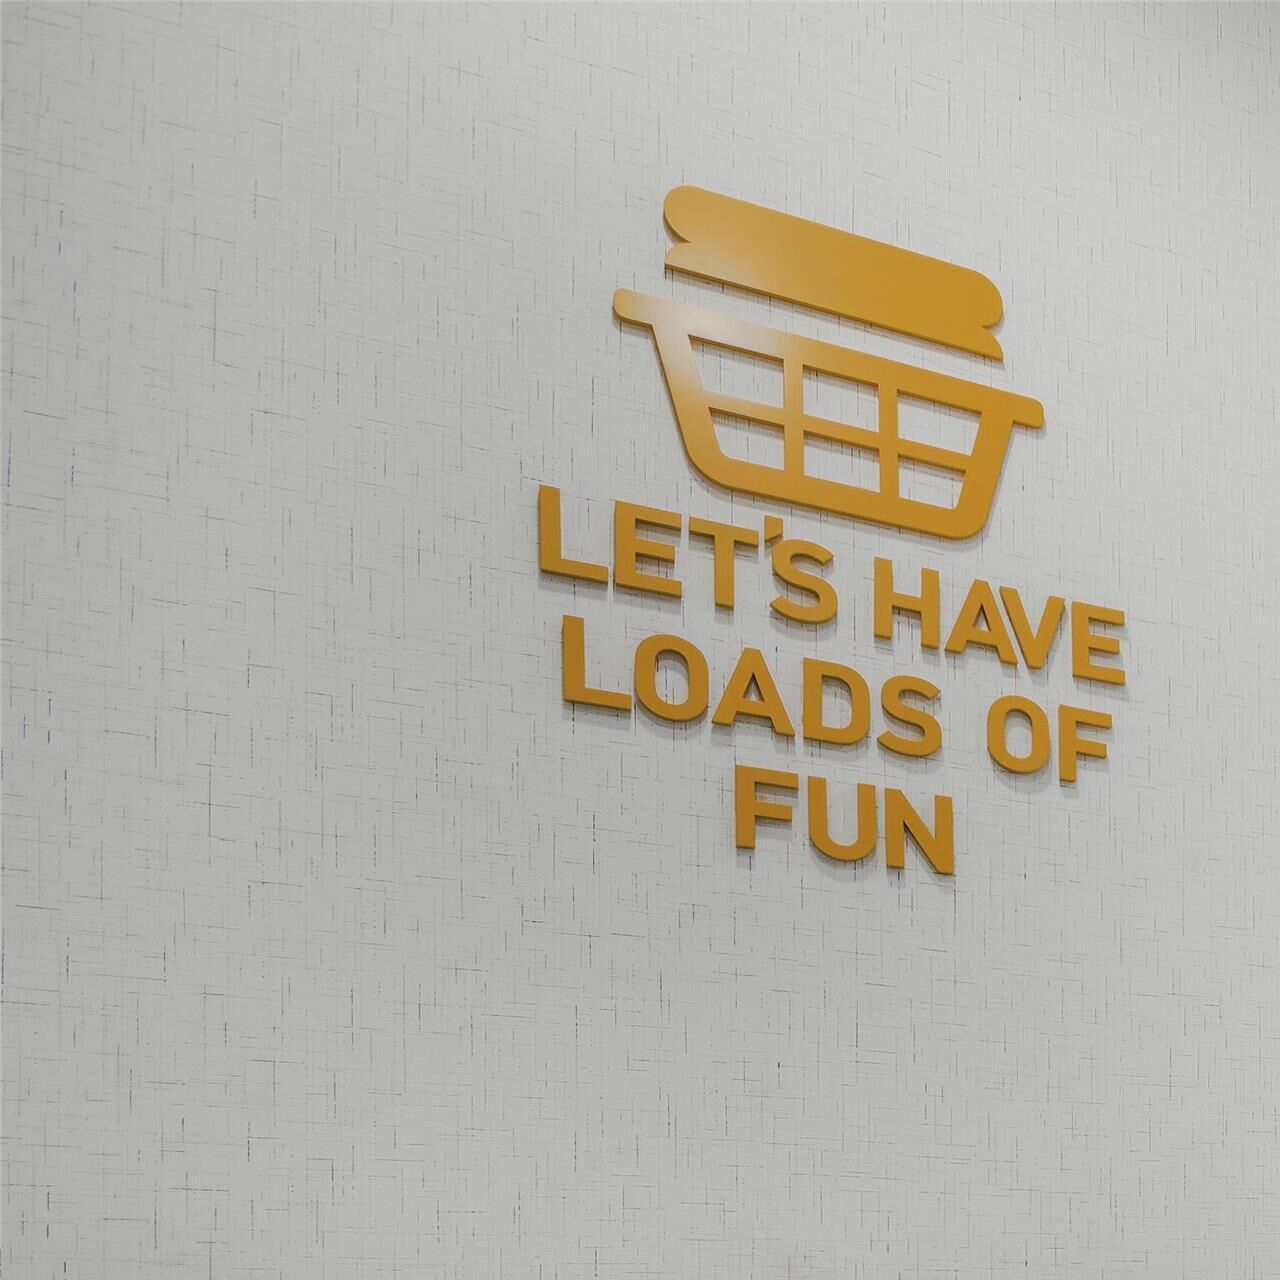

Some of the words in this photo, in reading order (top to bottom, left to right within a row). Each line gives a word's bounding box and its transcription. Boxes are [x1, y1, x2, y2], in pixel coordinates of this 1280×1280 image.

[538, 484, 839, 624] LET'S
[873, 556, 1127, 685] HAVE
[562, 614, 943, 758] LOADS
[986, 694, 1113, 783] OF
[735, 764, 955, 876] FUN
